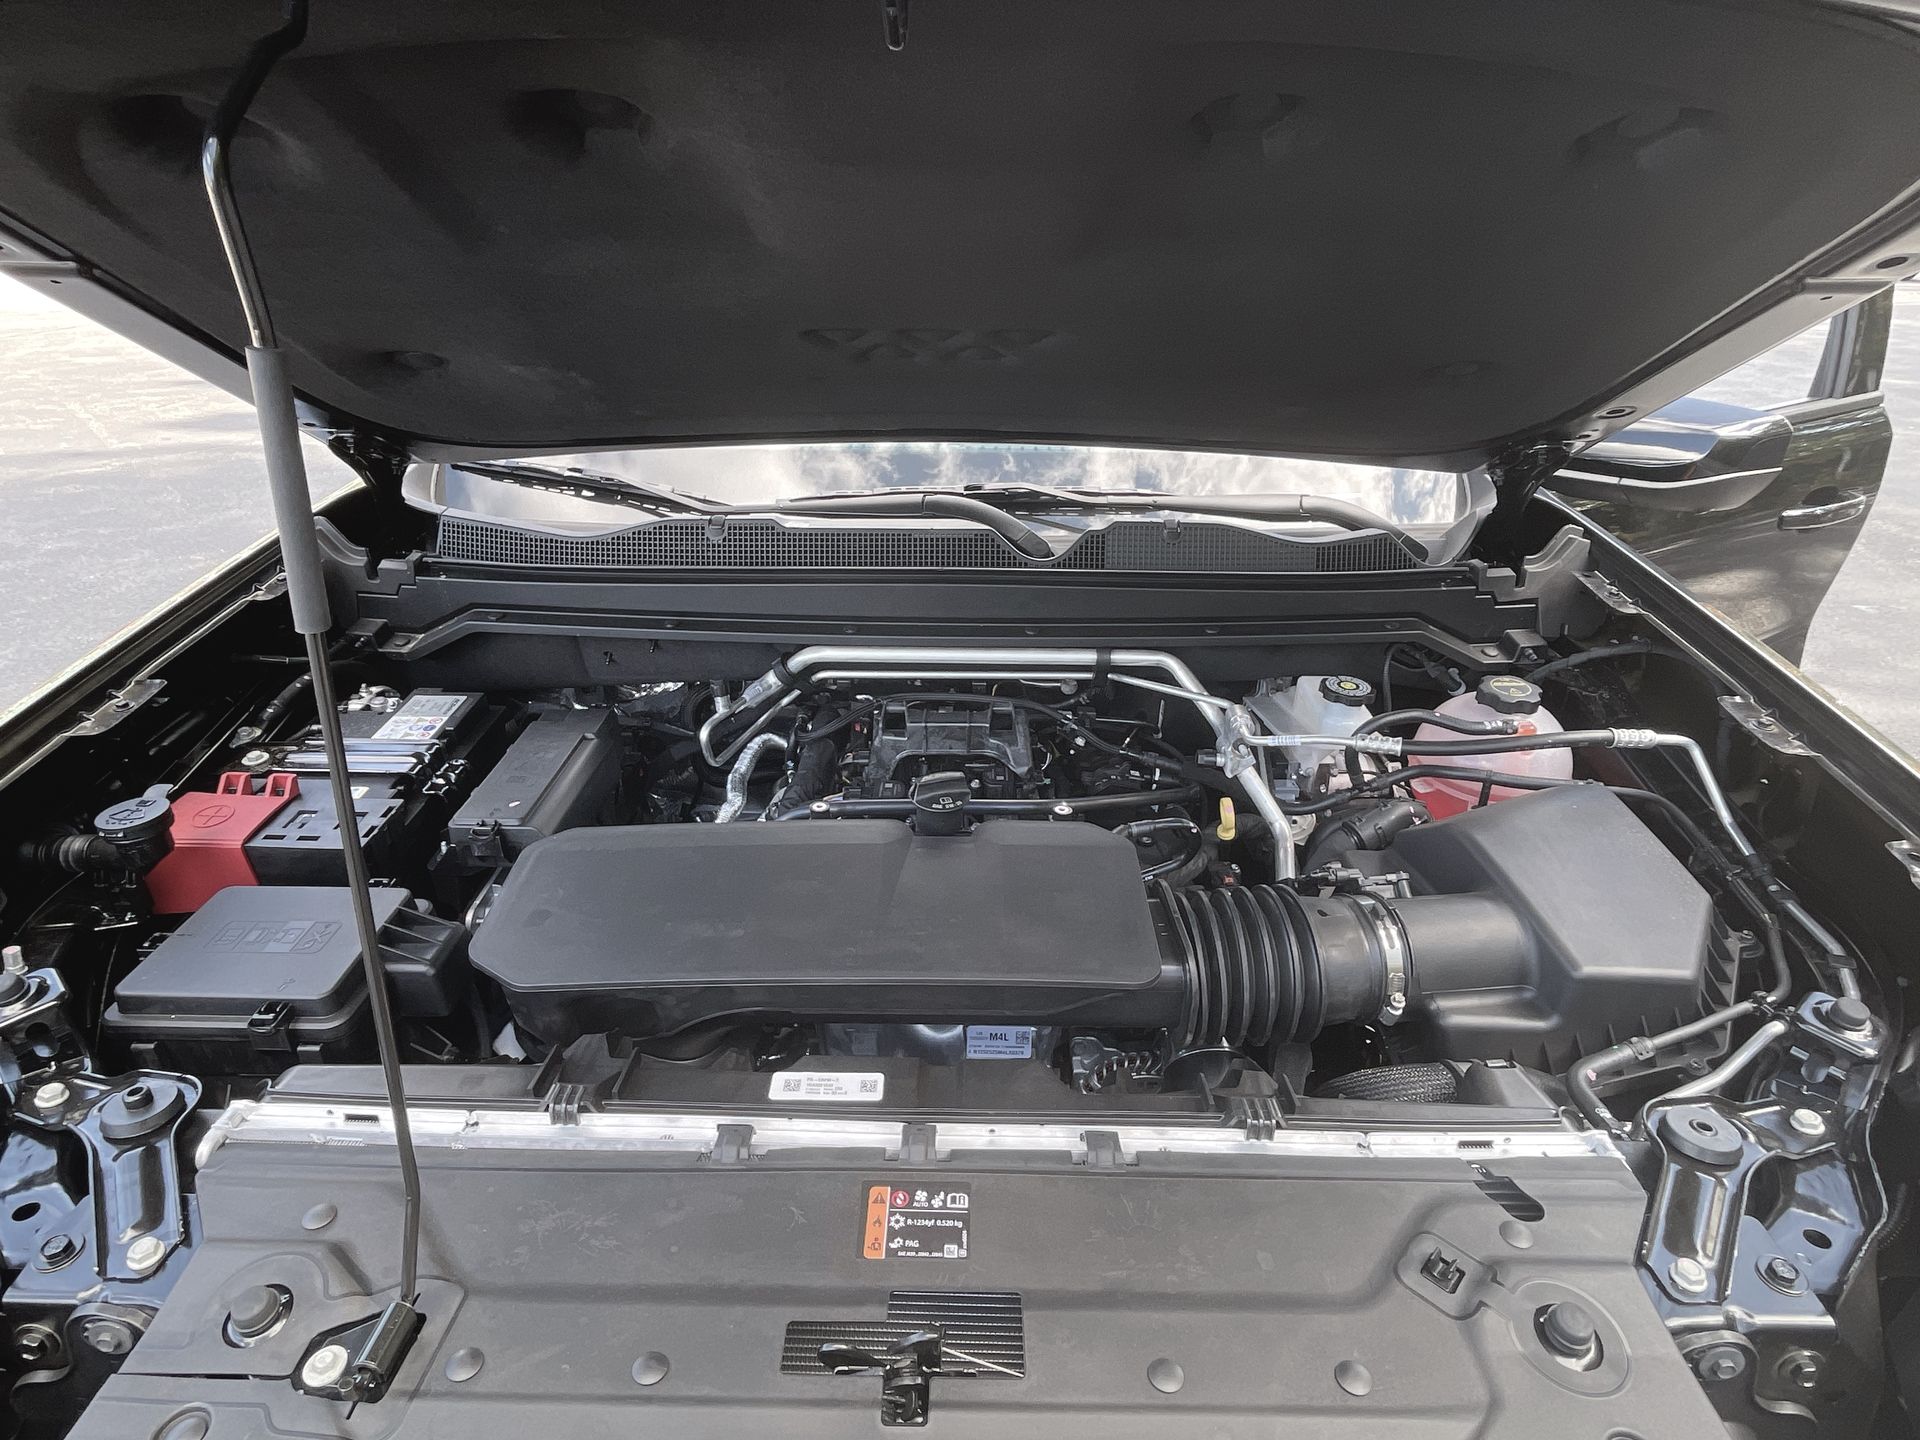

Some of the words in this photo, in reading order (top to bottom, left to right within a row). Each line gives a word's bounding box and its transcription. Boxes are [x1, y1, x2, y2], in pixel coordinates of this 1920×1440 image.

[989, 1032, 1009, 1042] M4L
[906, 1219, 935, 1228] R-1234yf
[936, 1219, 954, 1227] 0.520
[954, 1219, 963, 1228] kg
[904, 1240, 920, 1248] PAG
